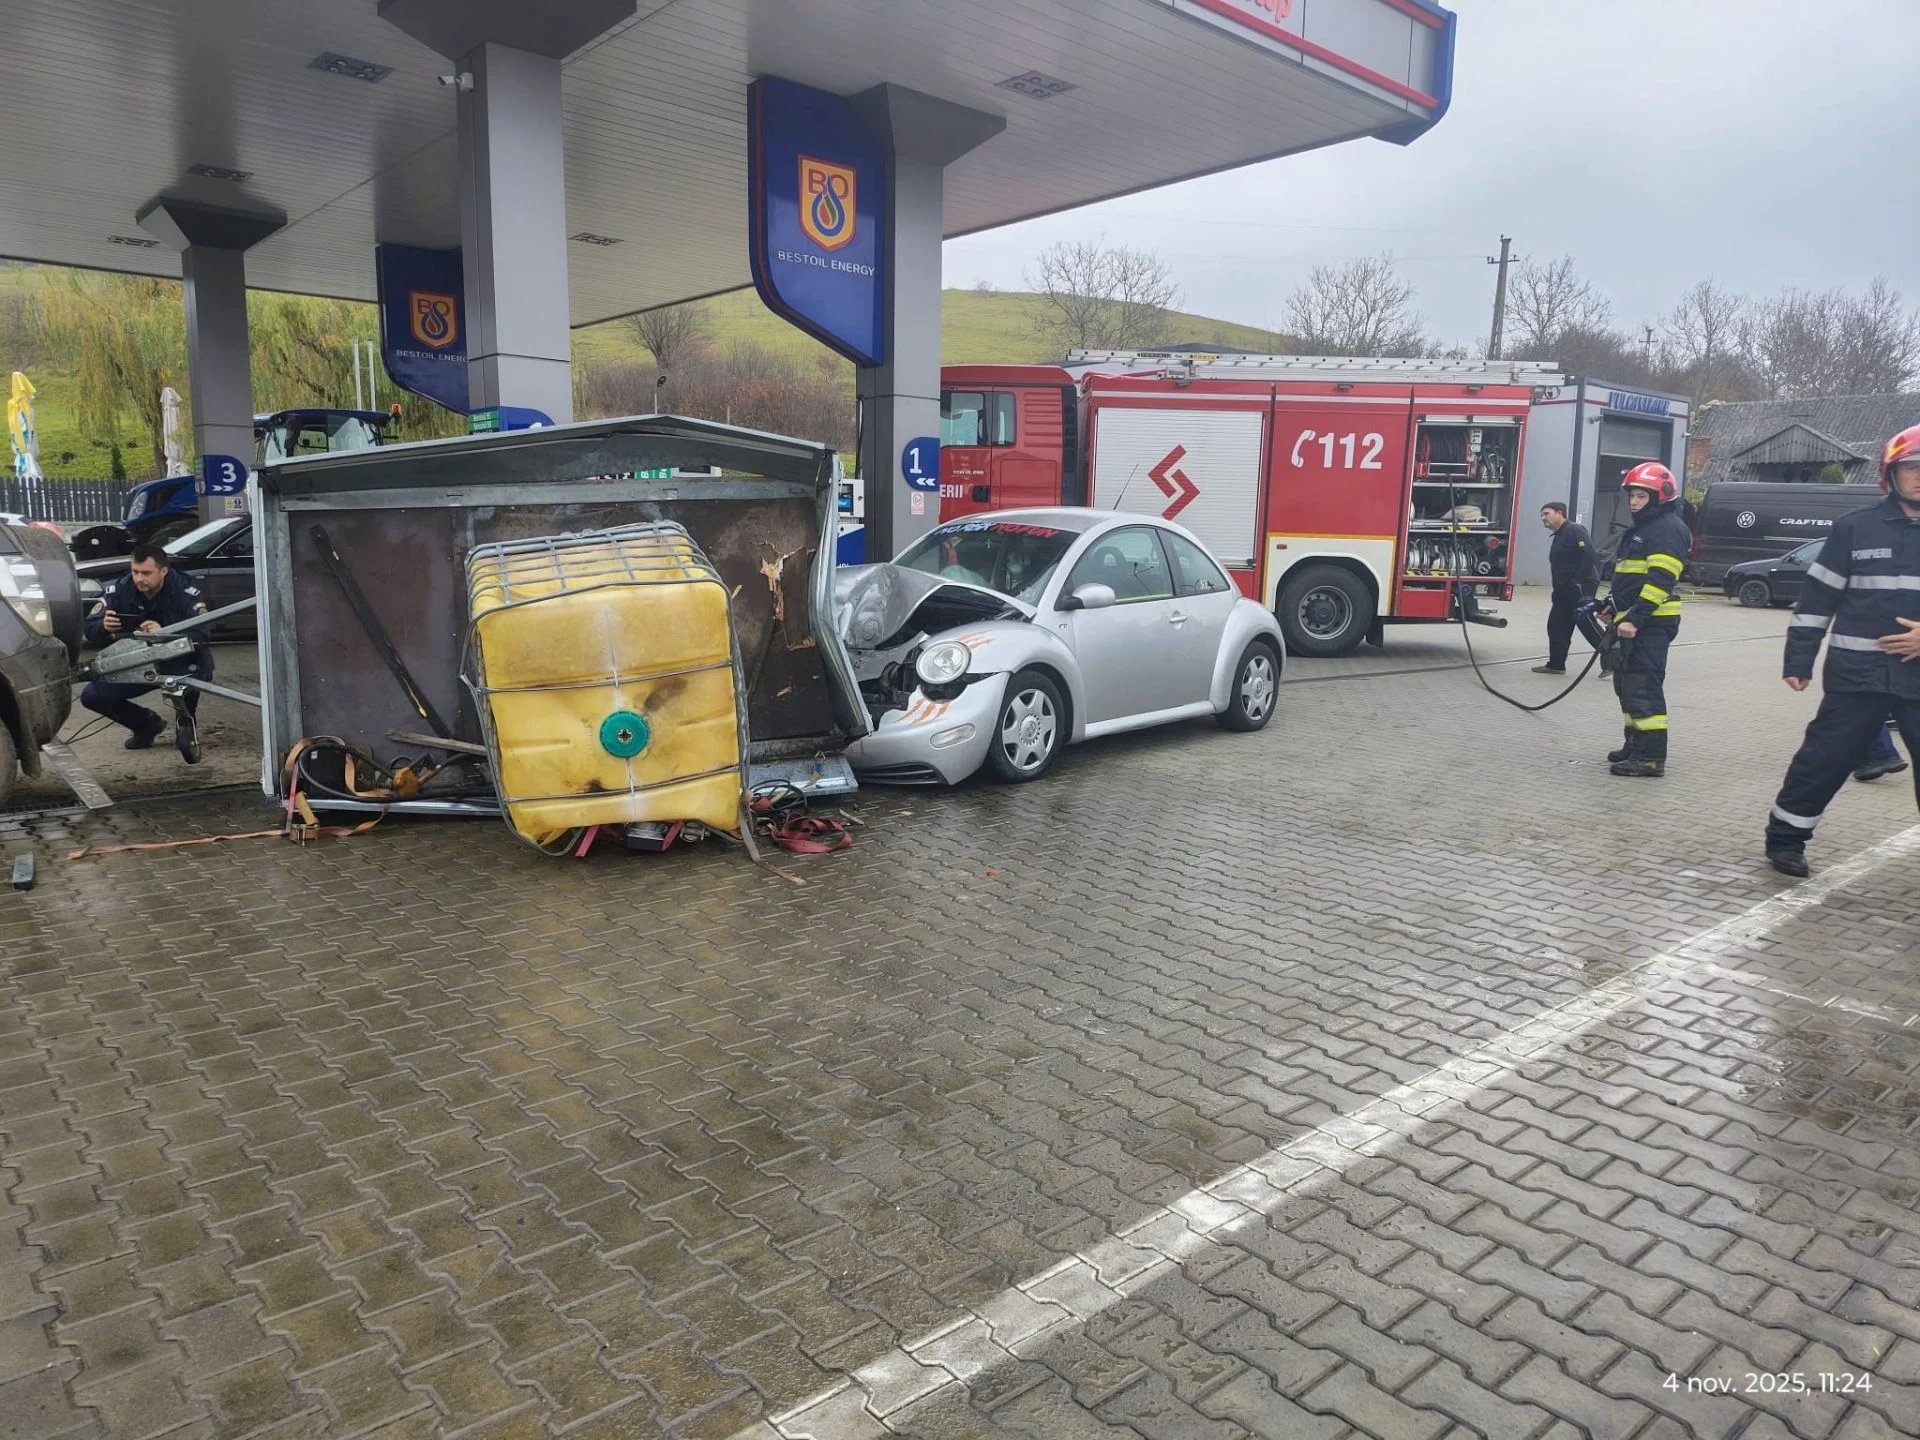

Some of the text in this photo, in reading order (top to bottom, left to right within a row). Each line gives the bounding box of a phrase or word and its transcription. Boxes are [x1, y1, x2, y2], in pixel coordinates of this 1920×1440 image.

[778, 250, 875, 276] BESTOIL ENERGY
[396, 349, 436, 360] BESTOIL
[909, 447, 922, 474] 1
[1319, 432, 1384, 469] 112
[221, 462, 237, 483] 3
[1779, 518, 1833, 526] CRAFTER
